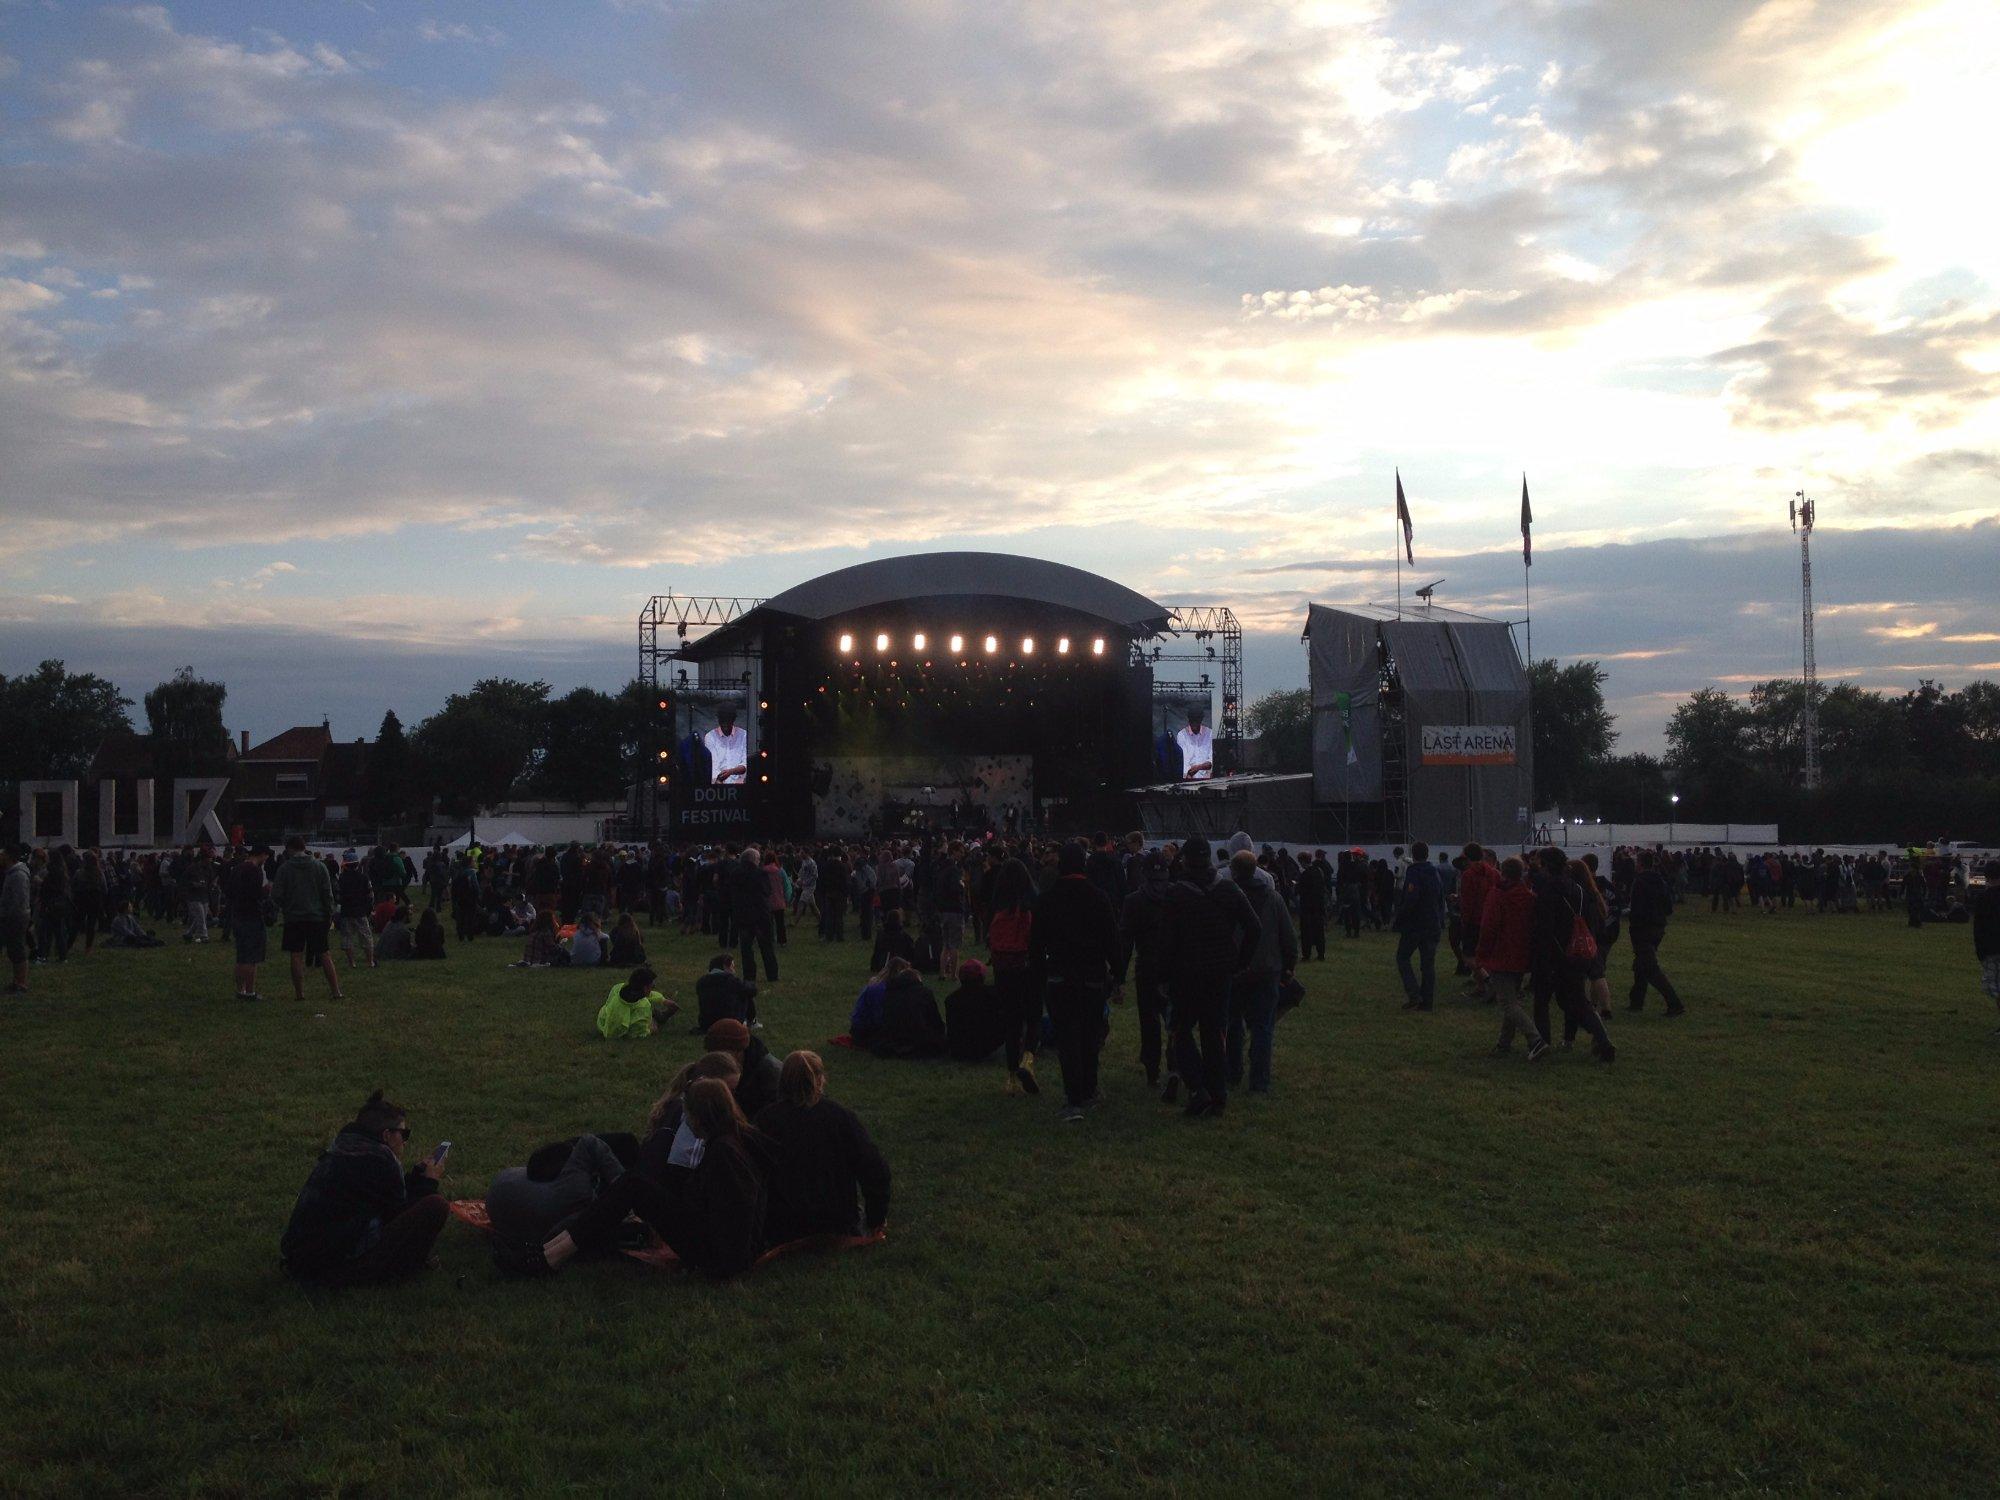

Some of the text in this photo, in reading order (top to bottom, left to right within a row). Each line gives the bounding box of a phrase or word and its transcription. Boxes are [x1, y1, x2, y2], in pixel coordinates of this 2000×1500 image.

[1424, 735, 1513, 750] LAST ARENA
[694, 787, 738, 802] DOUR
[681, 808, 751, 824] FESTIVAL
